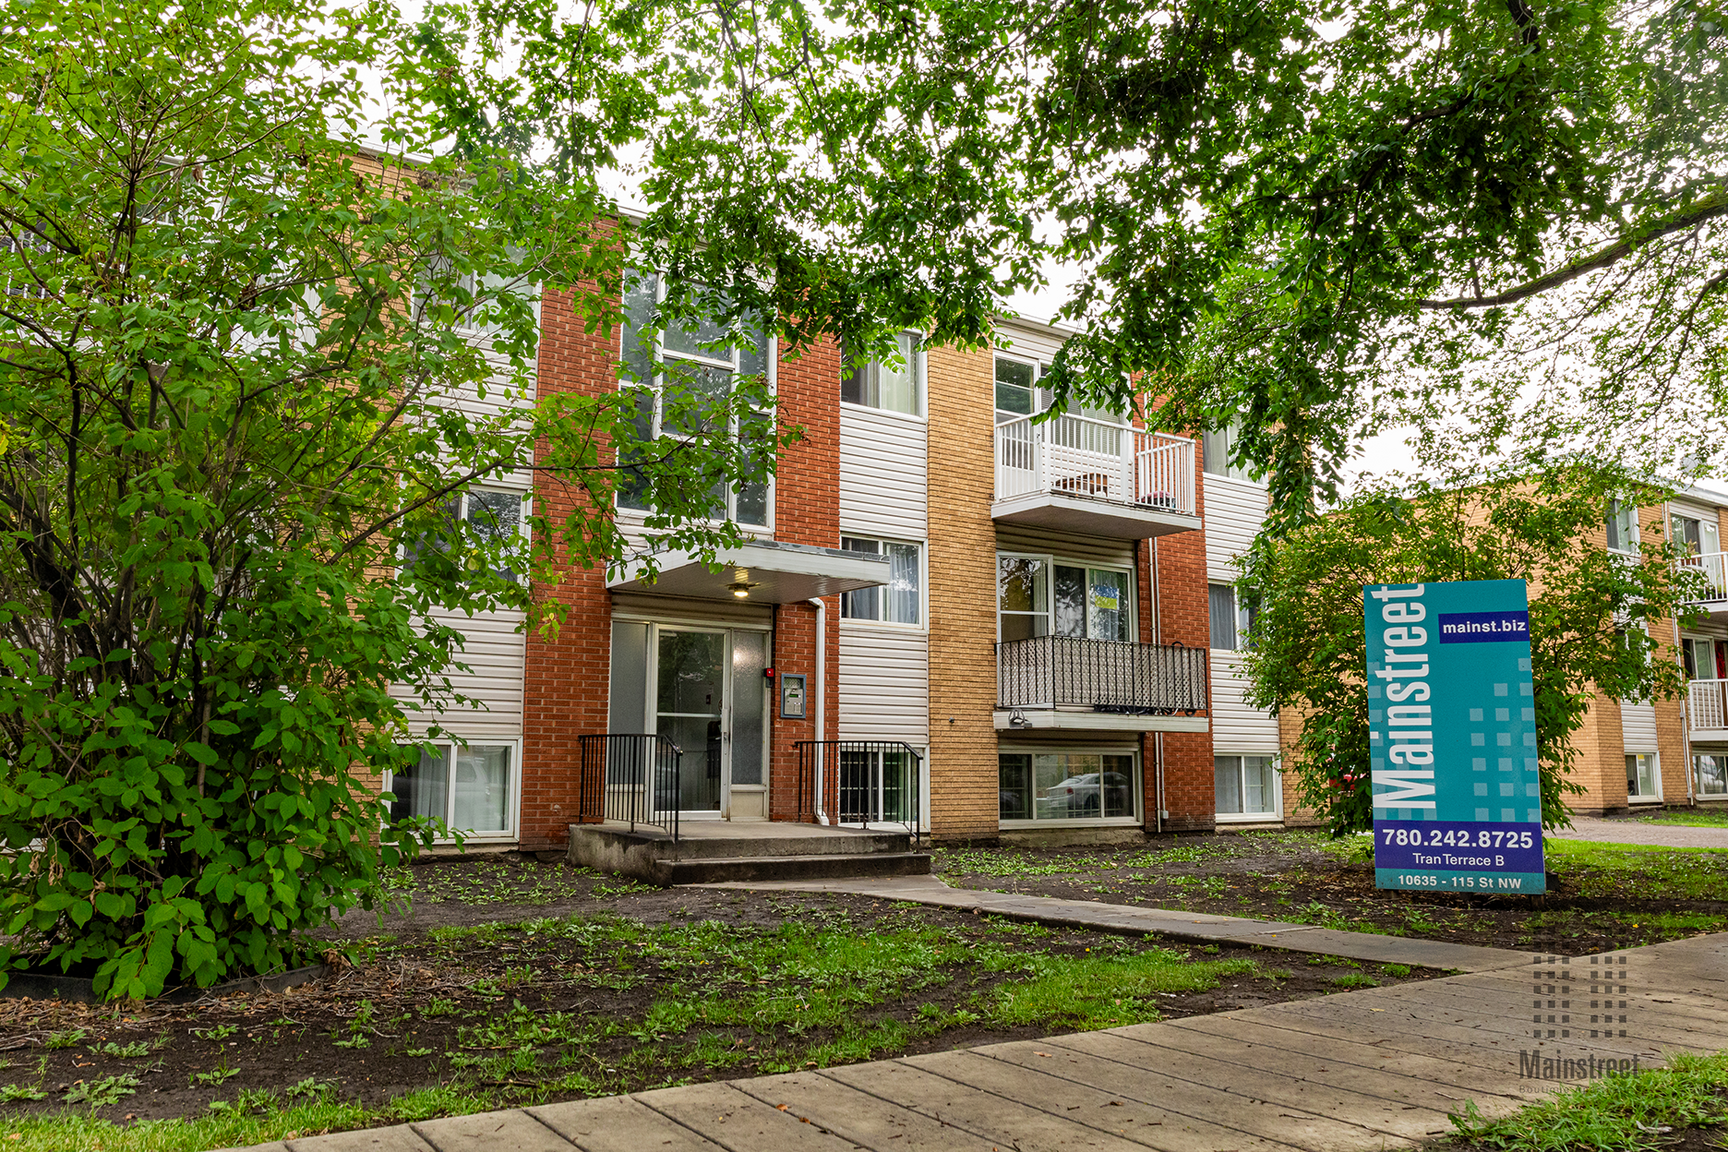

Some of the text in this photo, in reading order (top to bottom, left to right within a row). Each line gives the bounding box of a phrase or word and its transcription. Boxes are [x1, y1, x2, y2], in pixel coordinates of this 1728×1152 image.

[1443, 620, 1526, 633] mainst.biz
[1370, 584, 1437, 810] Mainstreet
[1382, 829, 1533, 849] 780.242.8725
[1412, 852, 1505, 866] Tran Terrace B
[1398, 875, 1437, 886] 10635
[1451, 877, 1474, 888] 115
[1479, 877, 1494, 888] St
[1498, 878, 1522, 889] NW
